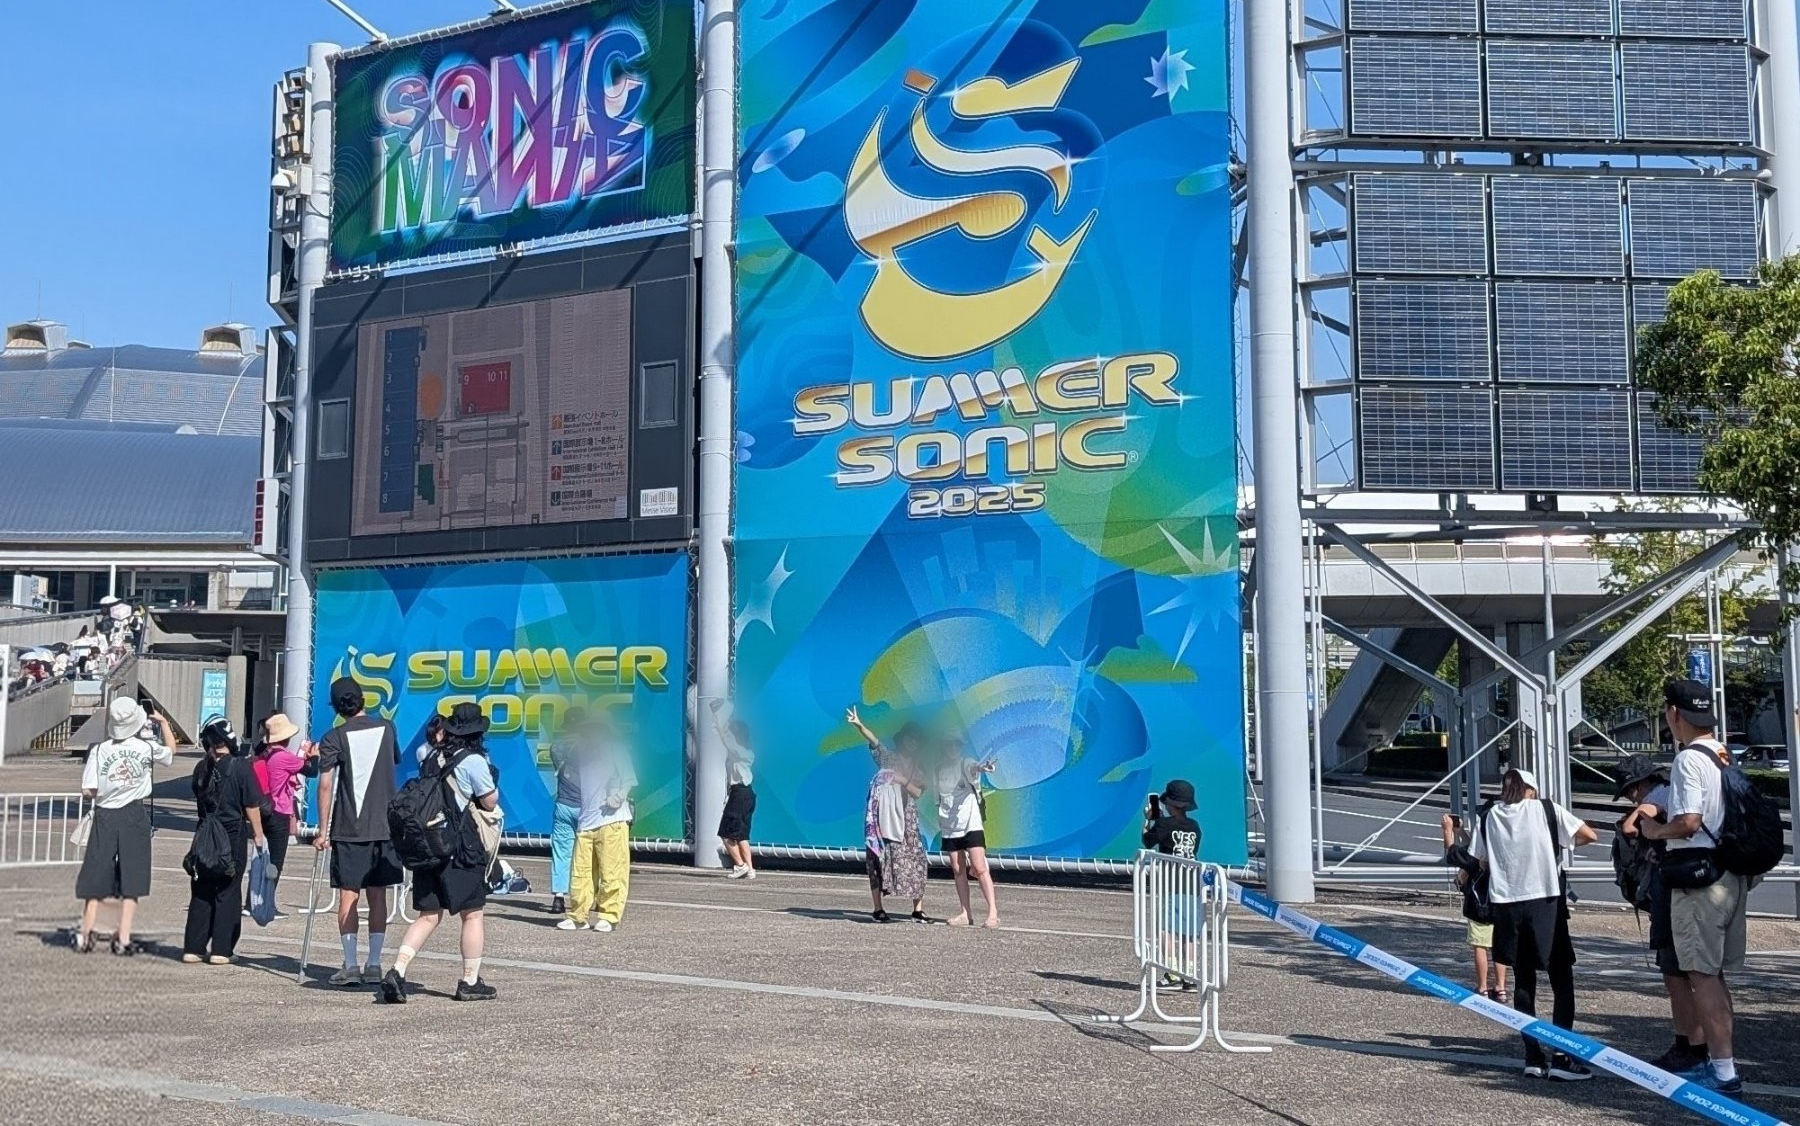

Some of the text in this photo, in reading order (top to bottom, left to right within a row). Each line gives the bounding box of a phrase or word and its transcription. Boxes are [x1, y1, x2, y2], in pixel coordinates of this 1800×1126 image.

[383, 29, 646, 159] SONIC
[387, 352, 393, 363] 2
[386, 373, 392, 384] 3
[463, 369, 508, 386] 9 10 11
[793, 350, 1184, 436] SUMMER
[385, 403, 391, 413] 4
[385, 424, 391, 435] 5
[383, 445, 390, 456] 6
[383, 471, 389, 482] 7
[382, 492, 388, 504] 8
[906, 481, 1048, 518] 2025
[406, 646, 670, 689] SUMMER
[101, 753, 118, 776] THREE
[1171, 830, 1197, 847] YES
